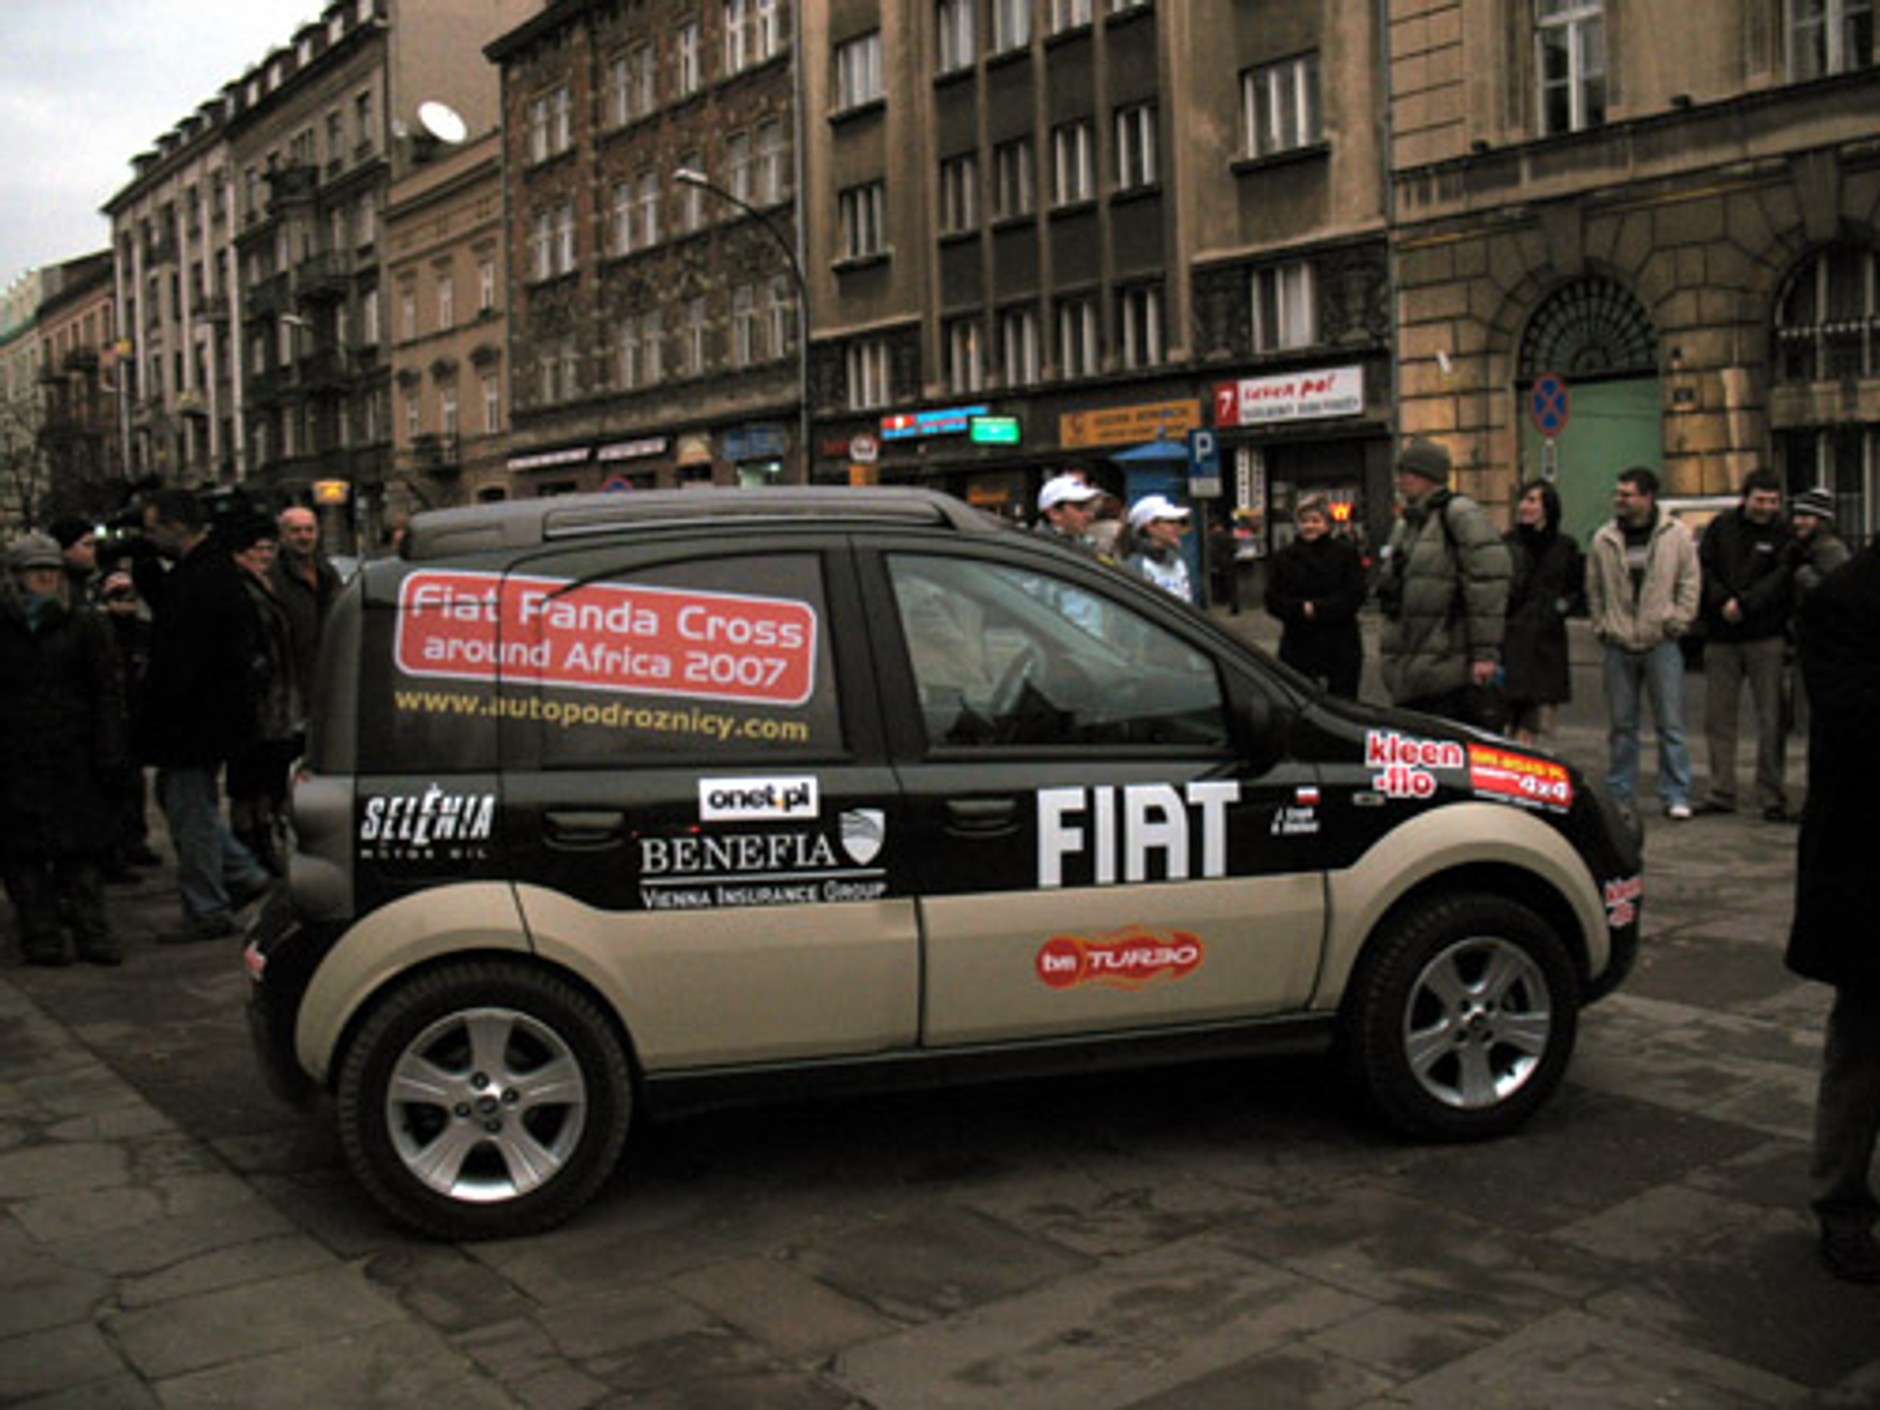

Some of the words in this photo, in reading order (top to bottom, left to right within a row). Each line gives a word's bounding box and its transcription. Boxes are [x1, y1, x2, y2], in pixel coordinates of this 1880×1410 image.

[1218, 390, 1233, 419] 7
[1195, 431, 1213, 463] P
[411, 584, 499, 622] Fiat
[519, 590, 659, 636] Panda
[676, 604, 804, 649] Cross
[422, 635, 552, 667] around
[562, 640, 672, 679] Africa
[684, 650, 788, 688] 2007
[395, 690, 810, 742] www.autopodroznicy.com
[1366, 730, 1463, 768] kleen
[708, 781, 810, 812] onet.pl
[1519, 774, 1568, 801] 4x4
[1037, 781, 1241, 887] FIAT
[640, 834, 838, 875] BENEFIA
